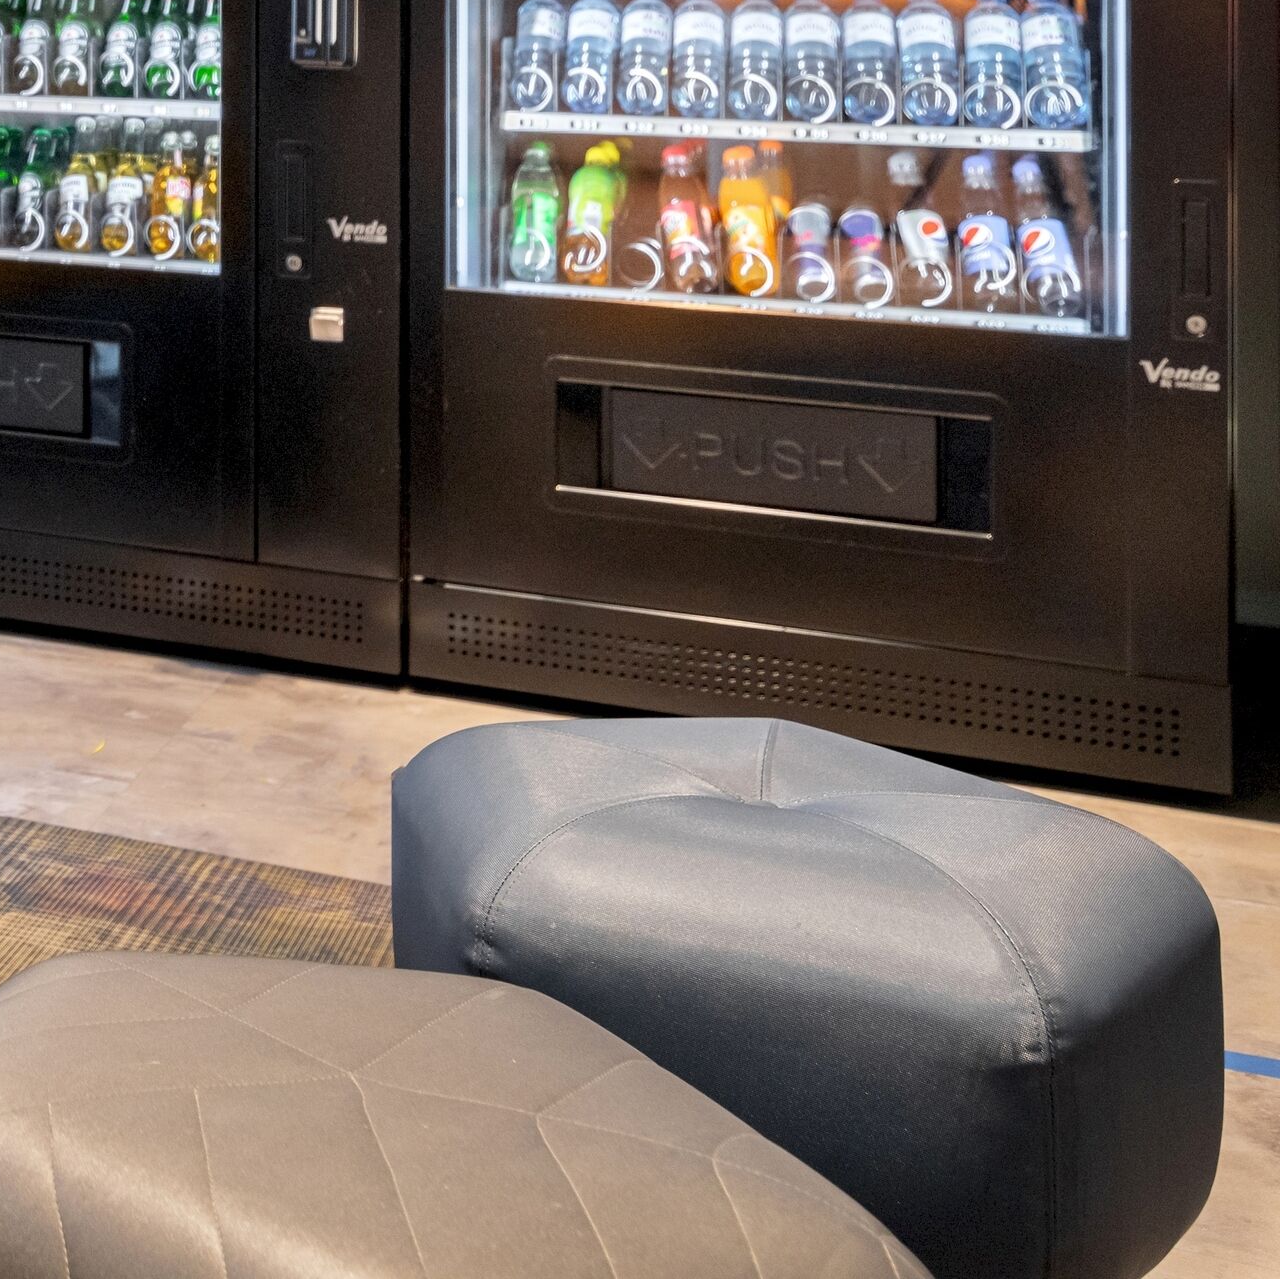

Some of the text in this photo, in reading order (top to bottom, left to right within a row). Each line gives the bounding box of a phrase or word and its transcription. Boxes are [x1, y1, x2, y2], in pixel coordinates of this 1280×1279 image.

[326, 215, 388, 239] Vendo
[1138, 357, 1221, 384] Vendo
[693, 431, 849, 486] PUSH
